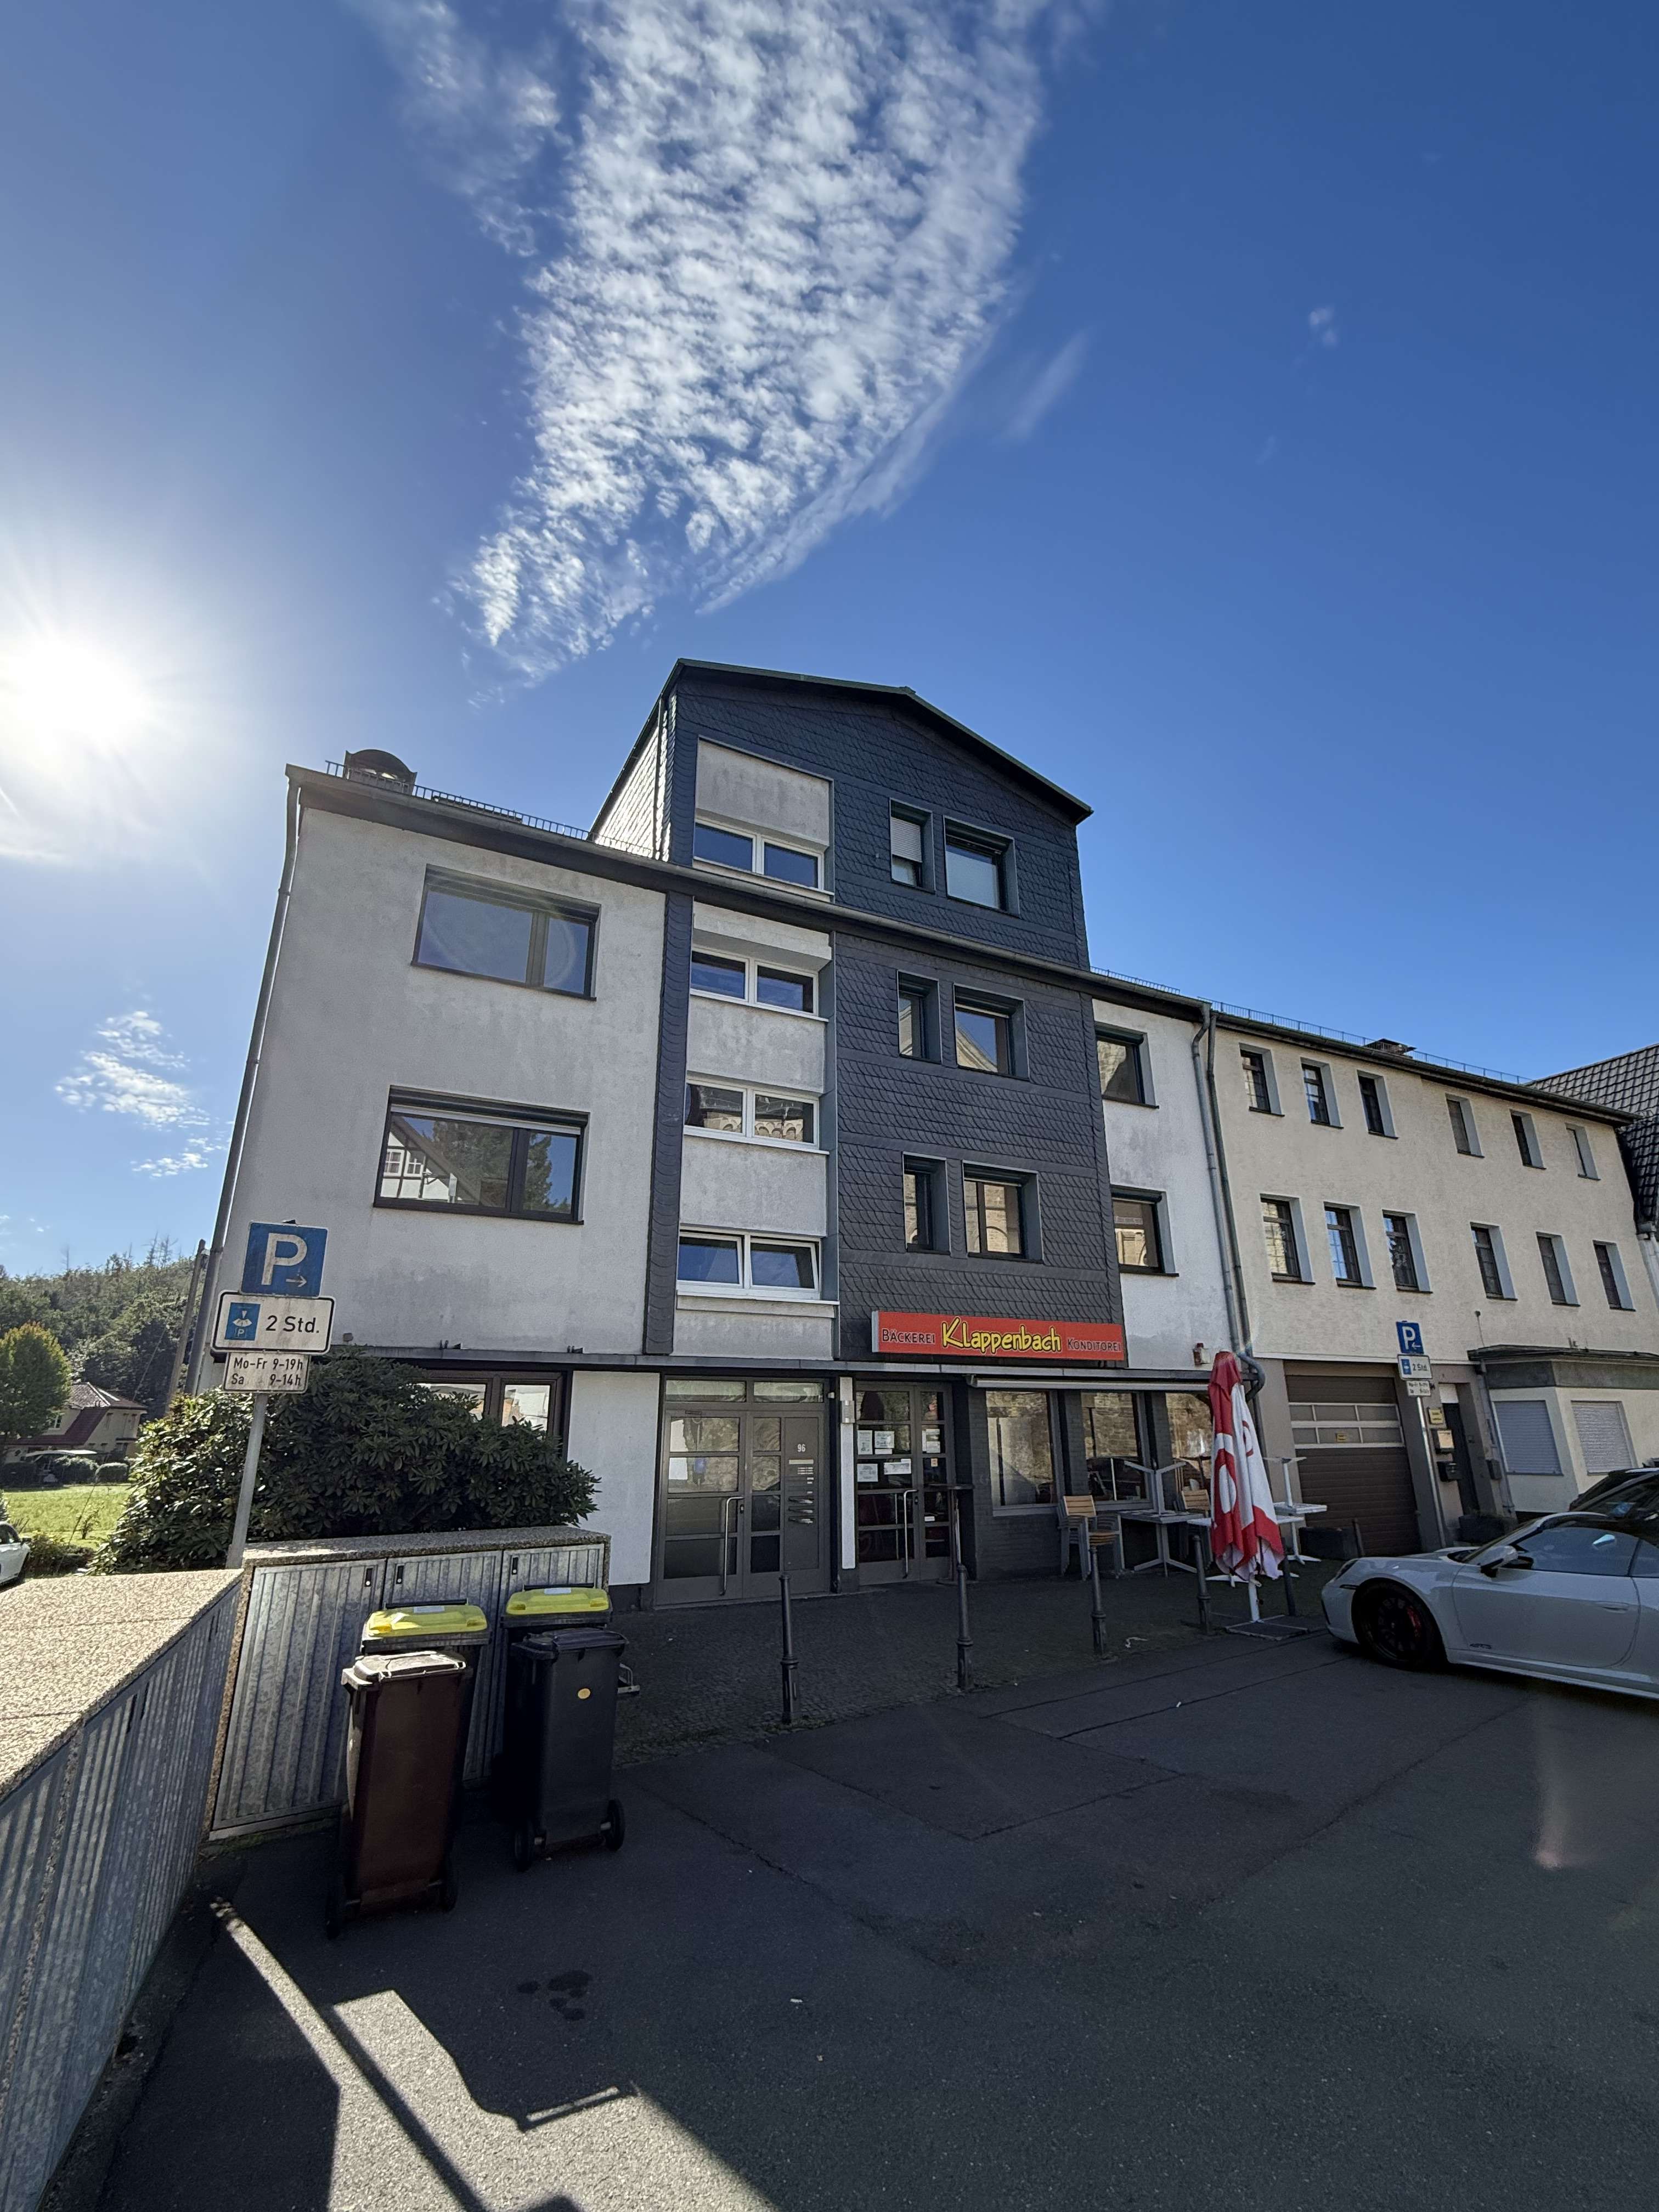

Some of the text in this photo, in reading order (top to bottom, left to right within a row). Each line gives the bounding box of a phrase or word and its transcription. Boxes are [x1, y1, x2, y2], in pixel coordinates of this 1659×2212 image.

[261, 1232, 307, 1285] P
[266, 1315, 320, 1334] 2 Std.
[238, 1329, 245, 1337] P
[882, 1317, 1121, 1353] BÄCKEREI Klappenbach KONDITOREI
[1402, 1326, 1416, 1350] P
[234, 1357, 267, 1369] Mo-Fr
[232, 1373, 245, 1385] Sa
[797, 1443, 806, 1452] 96
